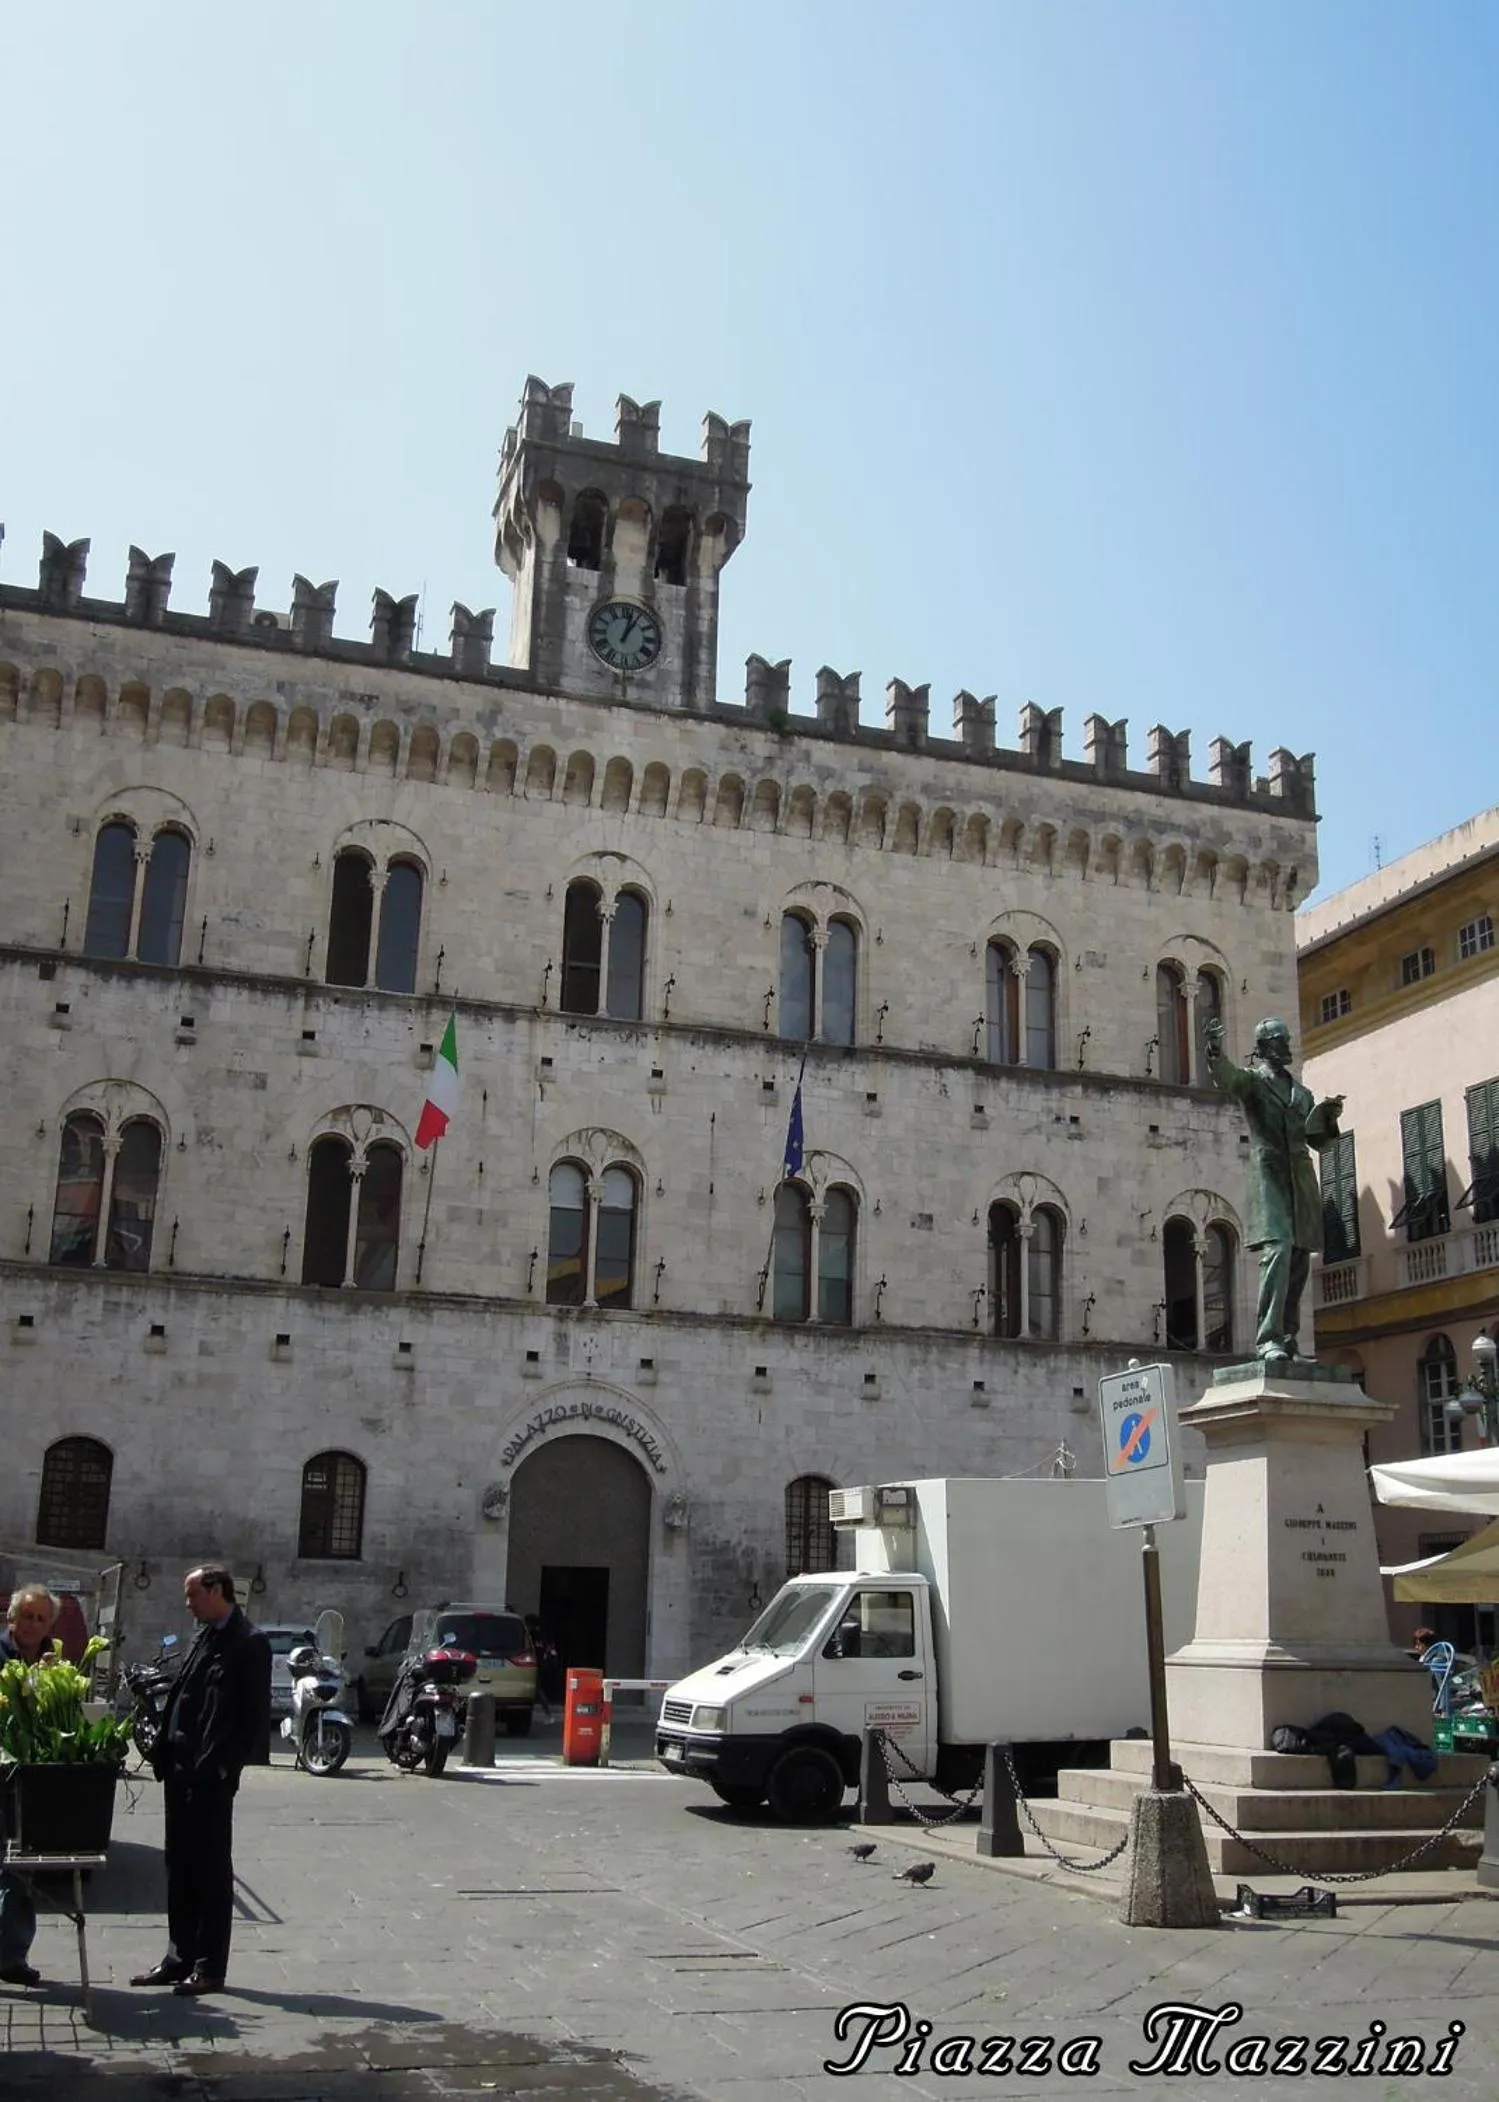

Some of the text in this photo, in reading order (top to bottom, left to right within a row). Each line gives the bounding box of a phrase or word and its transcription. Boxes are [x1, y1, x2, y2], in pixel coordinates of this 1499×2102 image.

[1121, 1380, 1139, 1393] area
[1113, 1388, 1152, 1412] pedonale
[503, 1405, 567, 1466] PALAZZO
